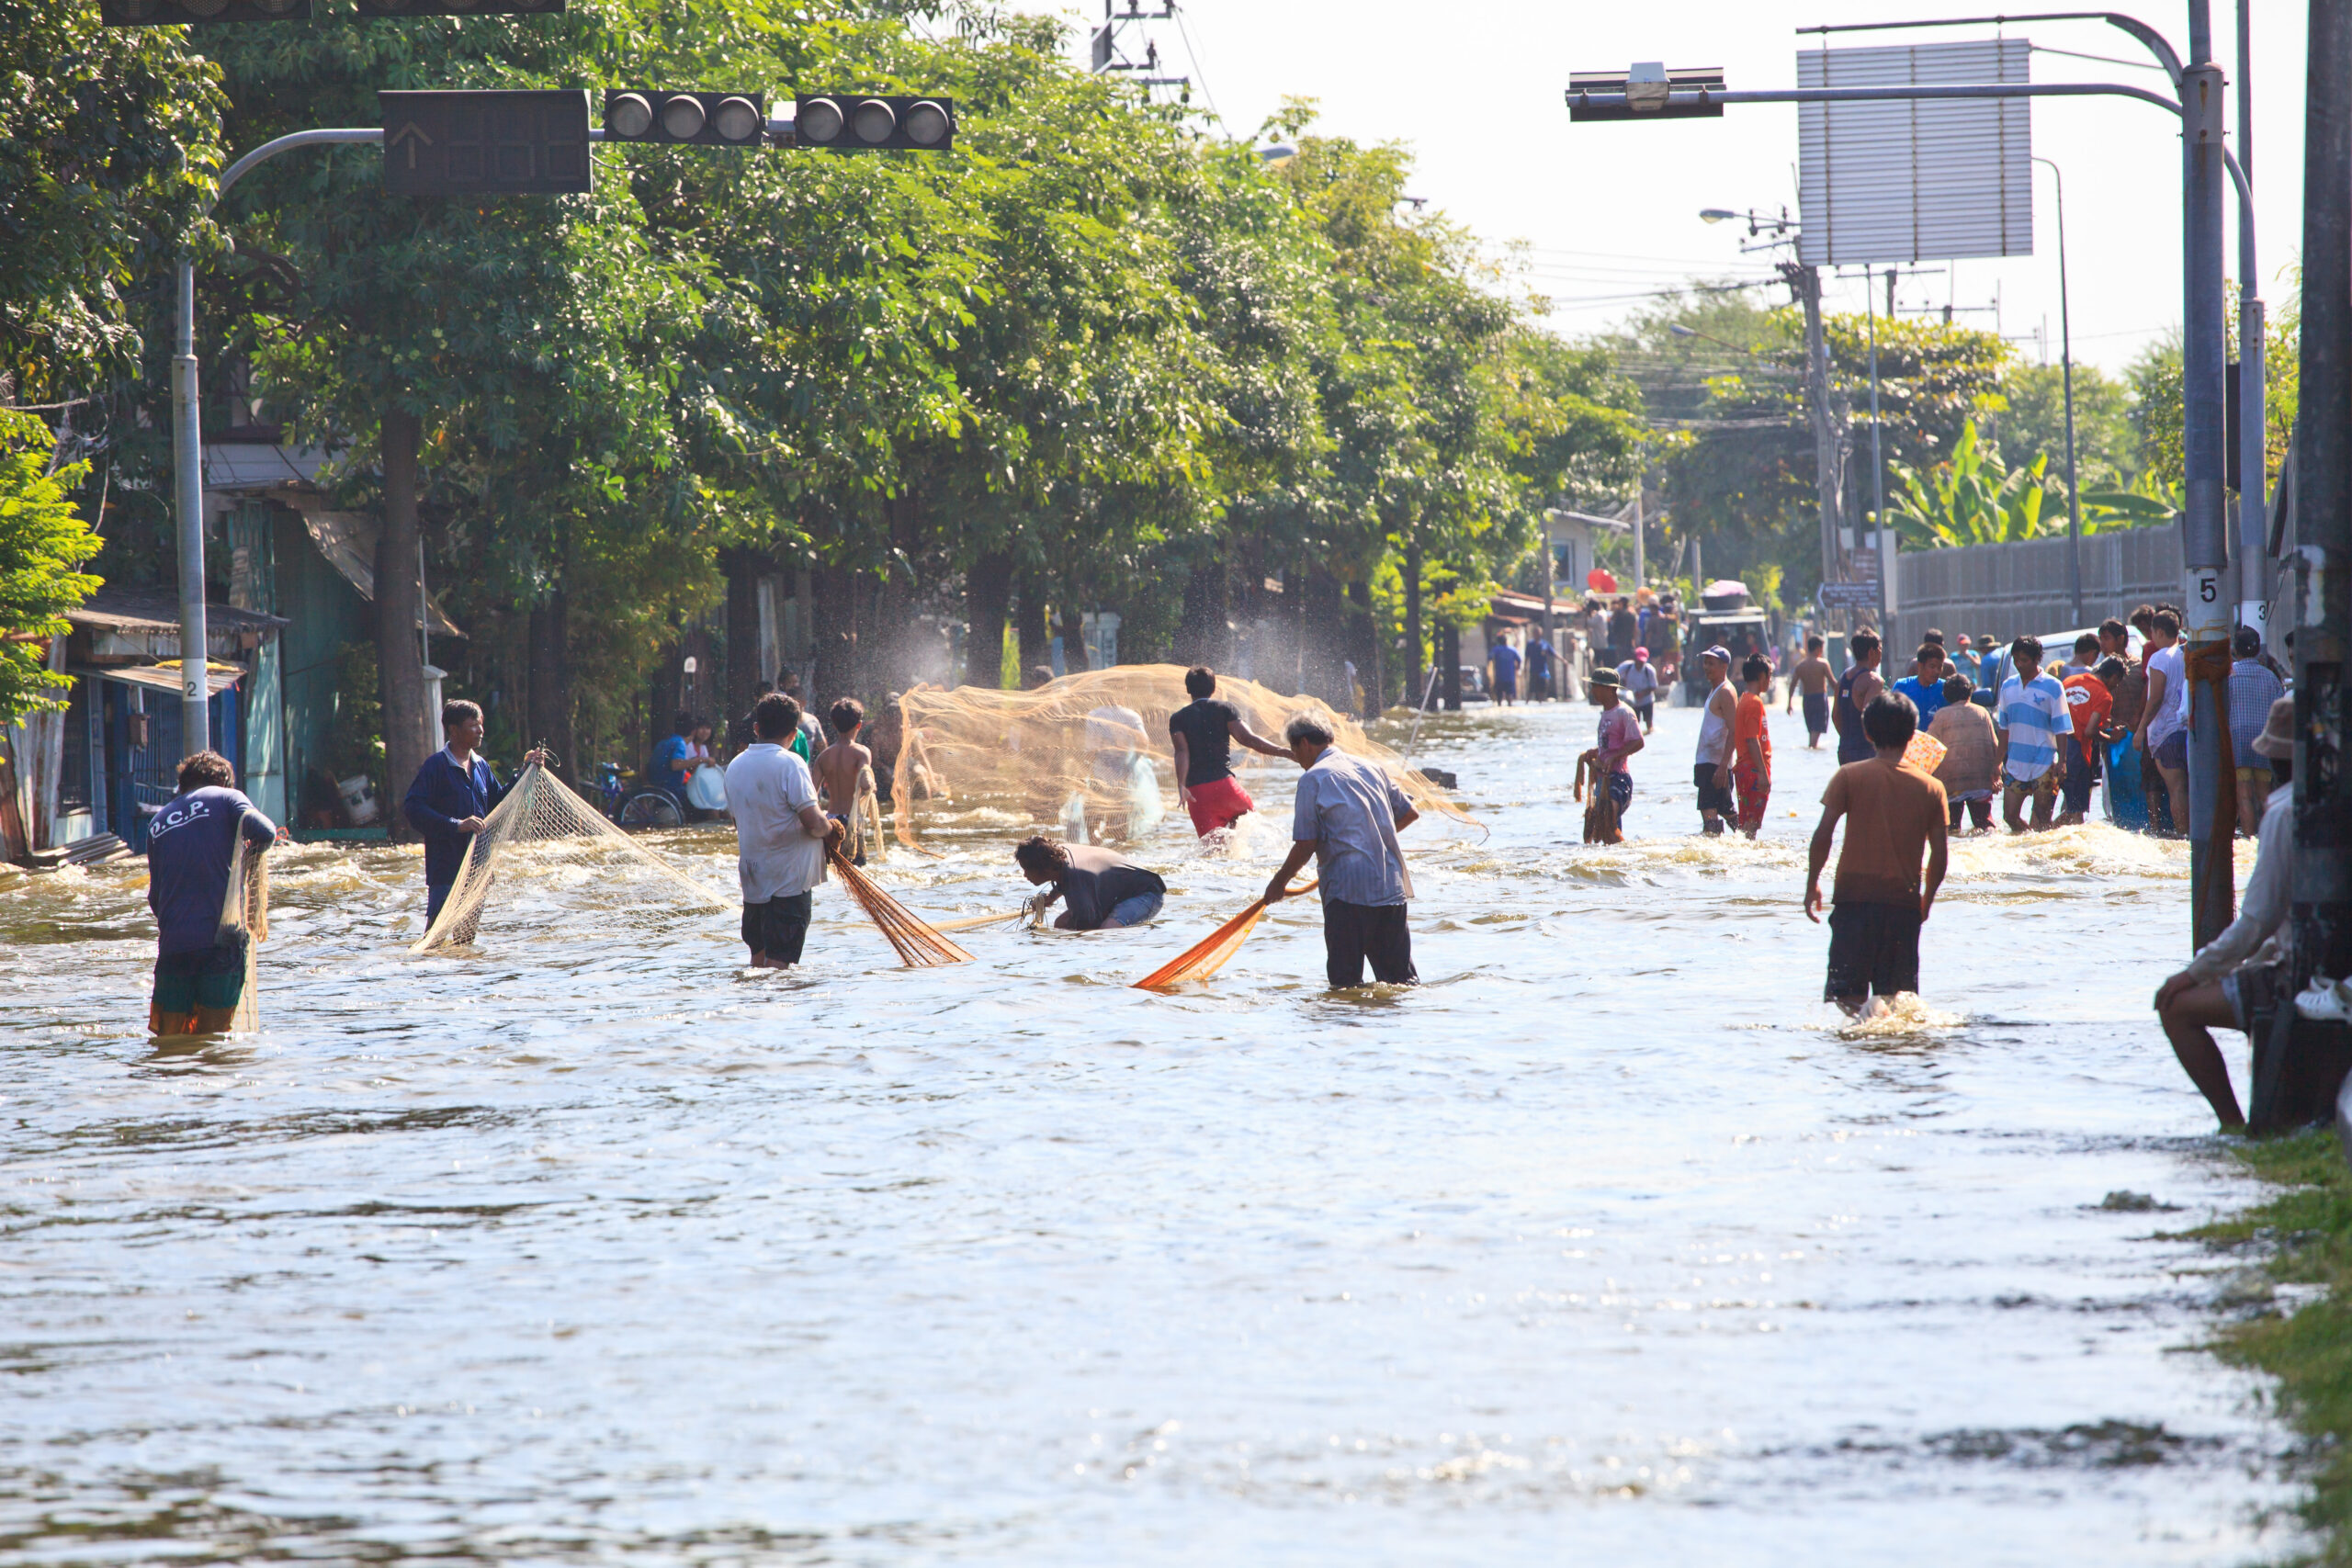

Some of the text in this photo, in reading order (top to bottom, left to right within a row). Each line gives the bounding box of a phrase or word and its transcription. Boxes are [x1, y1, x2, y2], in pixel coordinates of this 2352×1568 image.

[2200, 578, 2216, 603] 5
[2258, 604, 2266, 620] 3
[187, 681, 197, 696] 2
